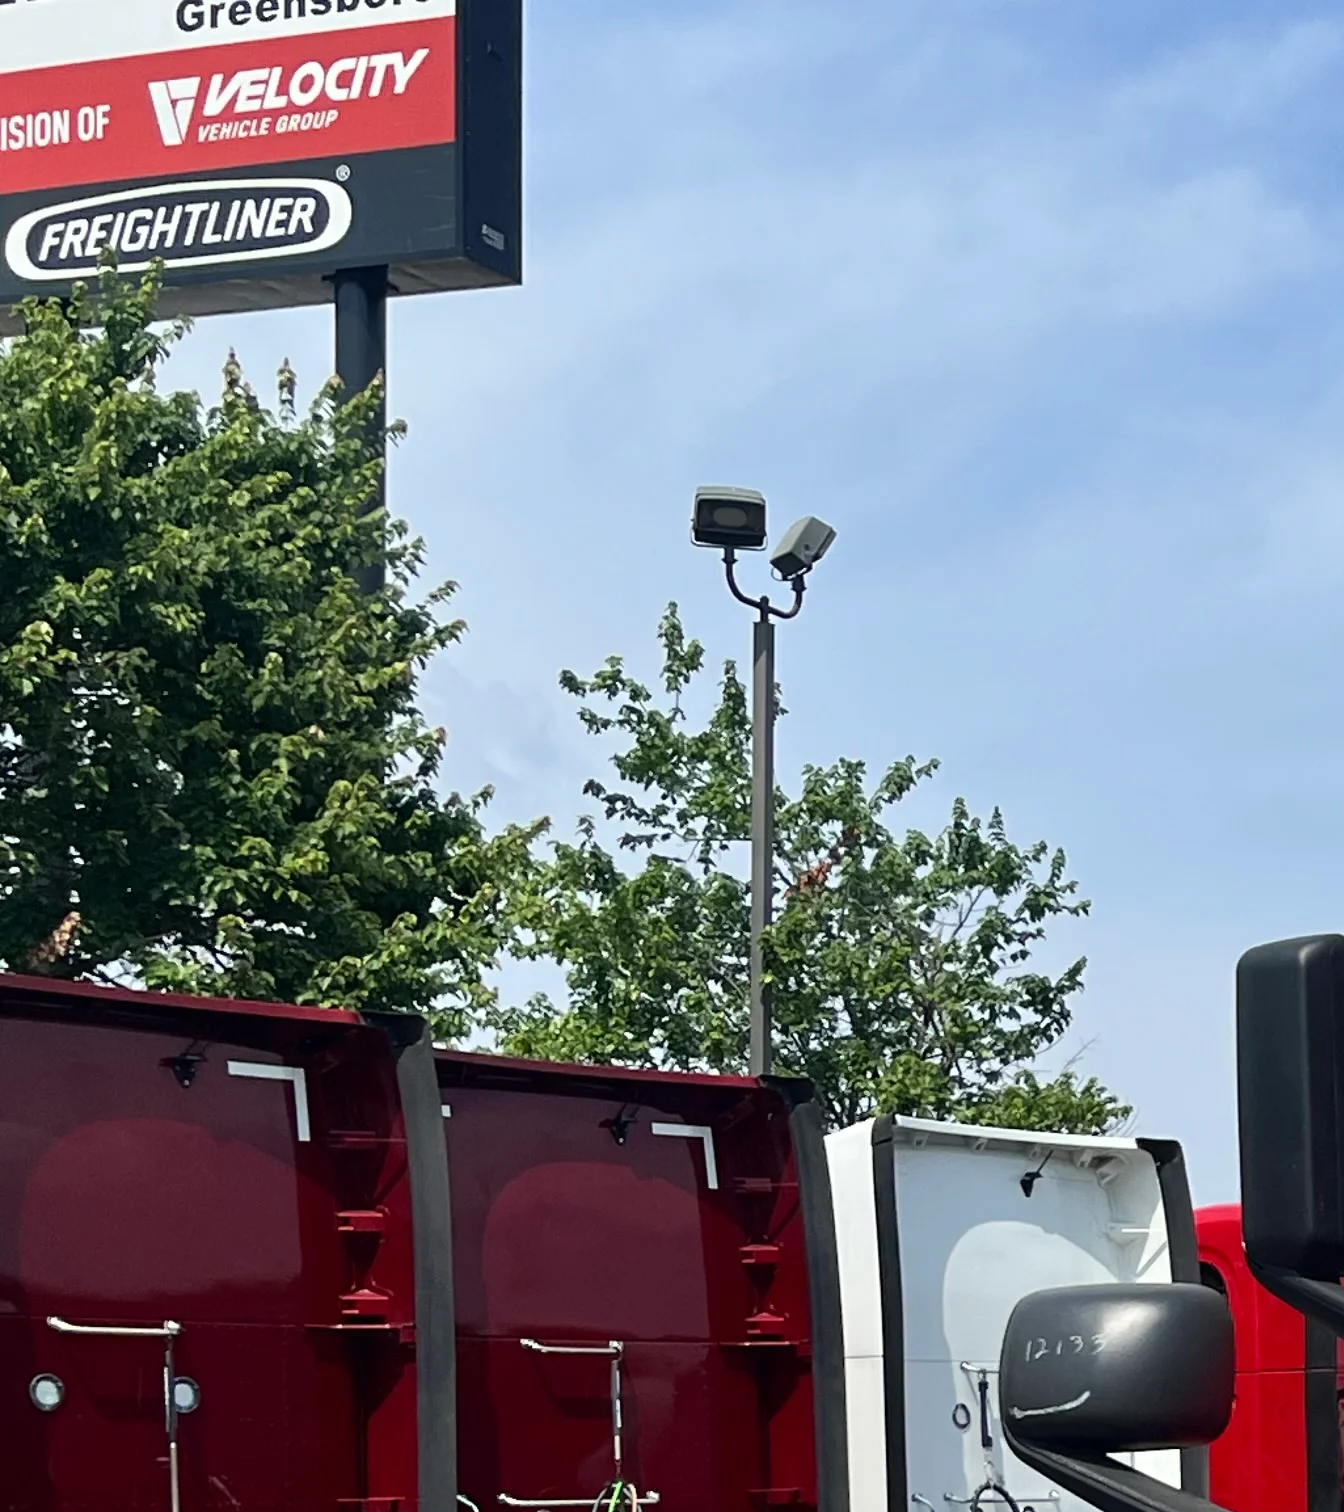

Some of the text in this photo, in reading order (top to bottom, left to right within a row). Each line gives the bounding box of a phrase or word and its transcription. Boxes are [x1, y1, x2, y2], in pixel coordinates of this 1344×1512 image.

[177, 0, 432, 32] Greens
[203, 48, 429, 117] VELOCITY
[77, 104, 111, 141] OF
[197, 109, 339, 143] VEHICLE GROUP
[38, 197, 316, 262] FREIGHTLINER
[1025, 1333, 1107, 1362] 12133
